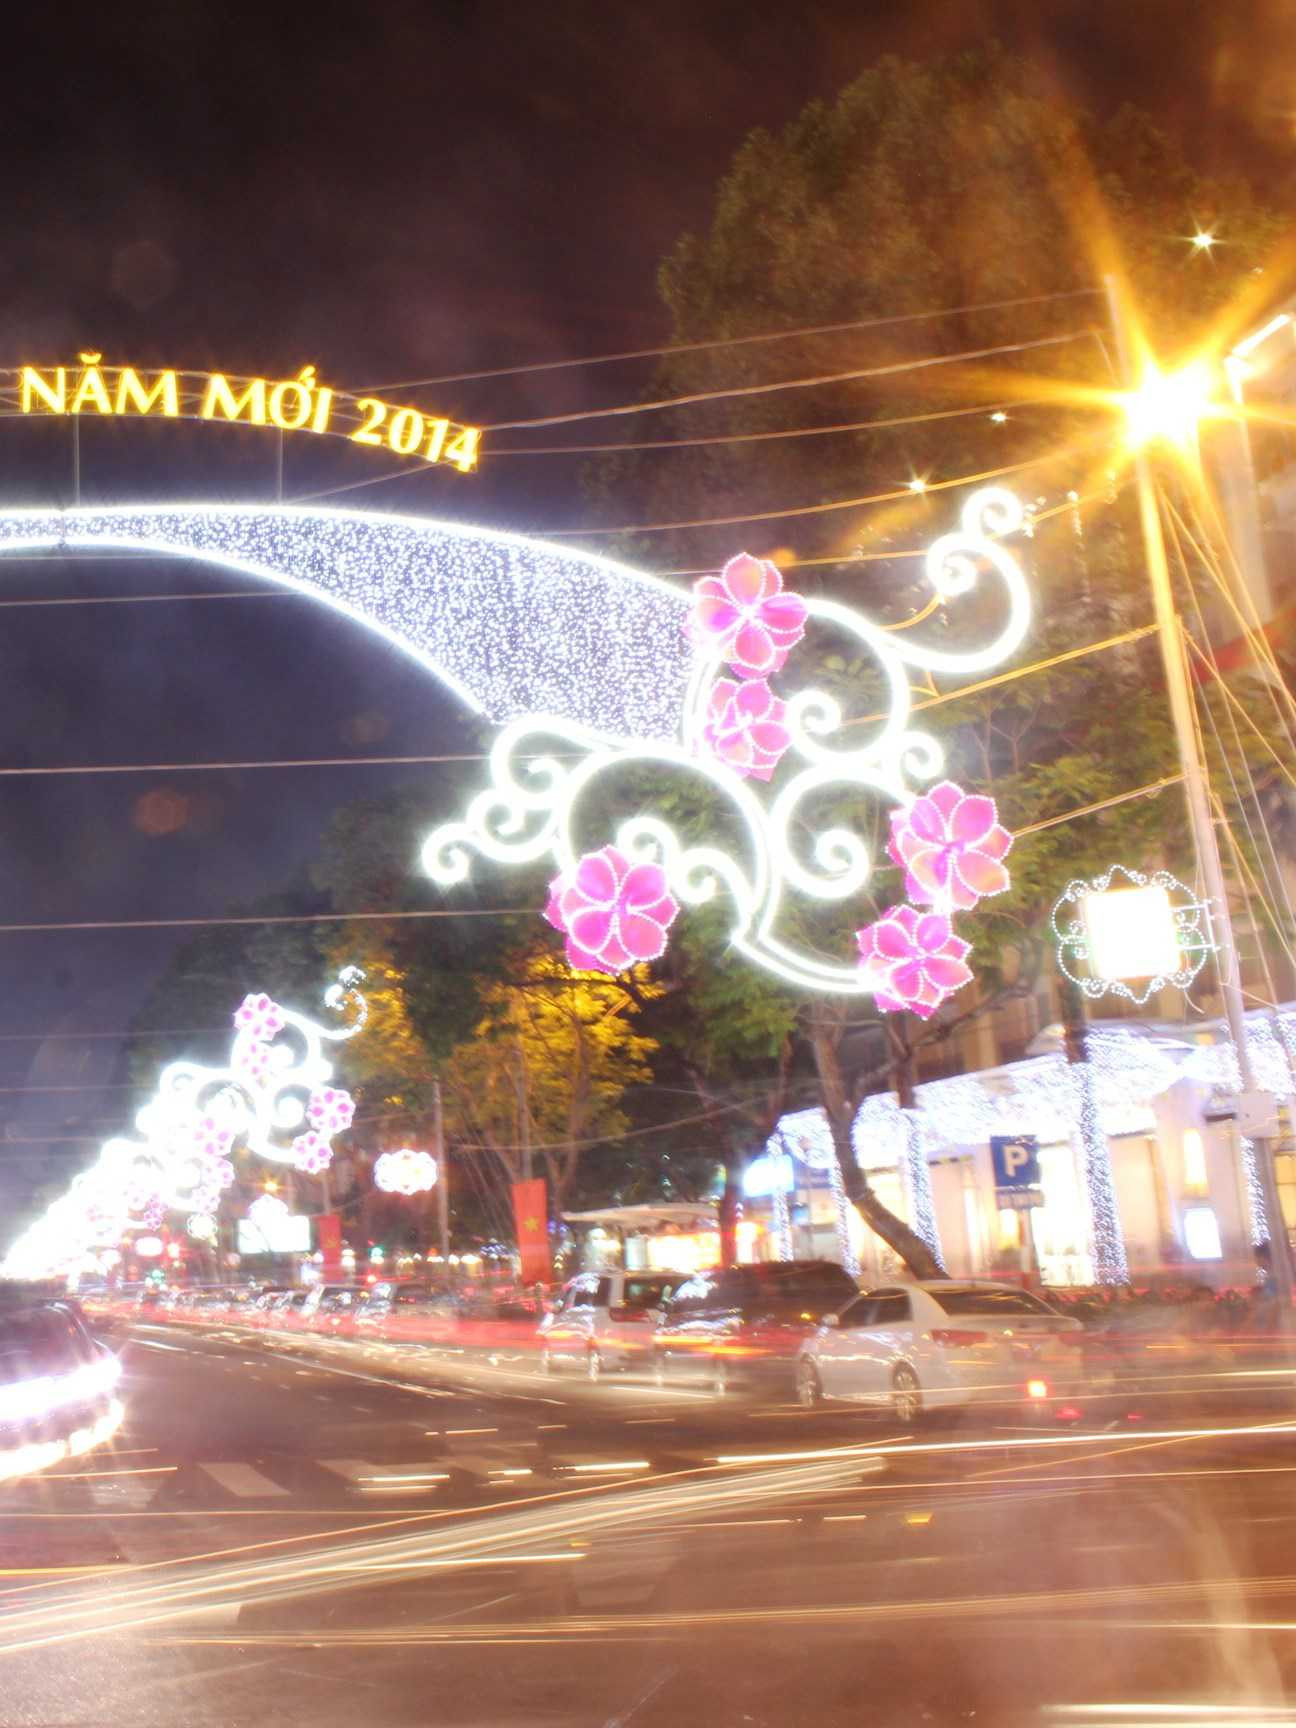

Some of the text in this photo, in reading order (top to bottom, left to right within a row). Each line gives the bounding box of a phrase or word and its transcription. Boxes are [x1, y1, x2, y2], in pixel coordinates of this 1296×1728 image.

[22, 352, 180, 417] NĂM
[202, 365, 333, 434] MỚI
[350, 397, 481, 473] 2014
[1004, 1145, 1029, 1177] P
